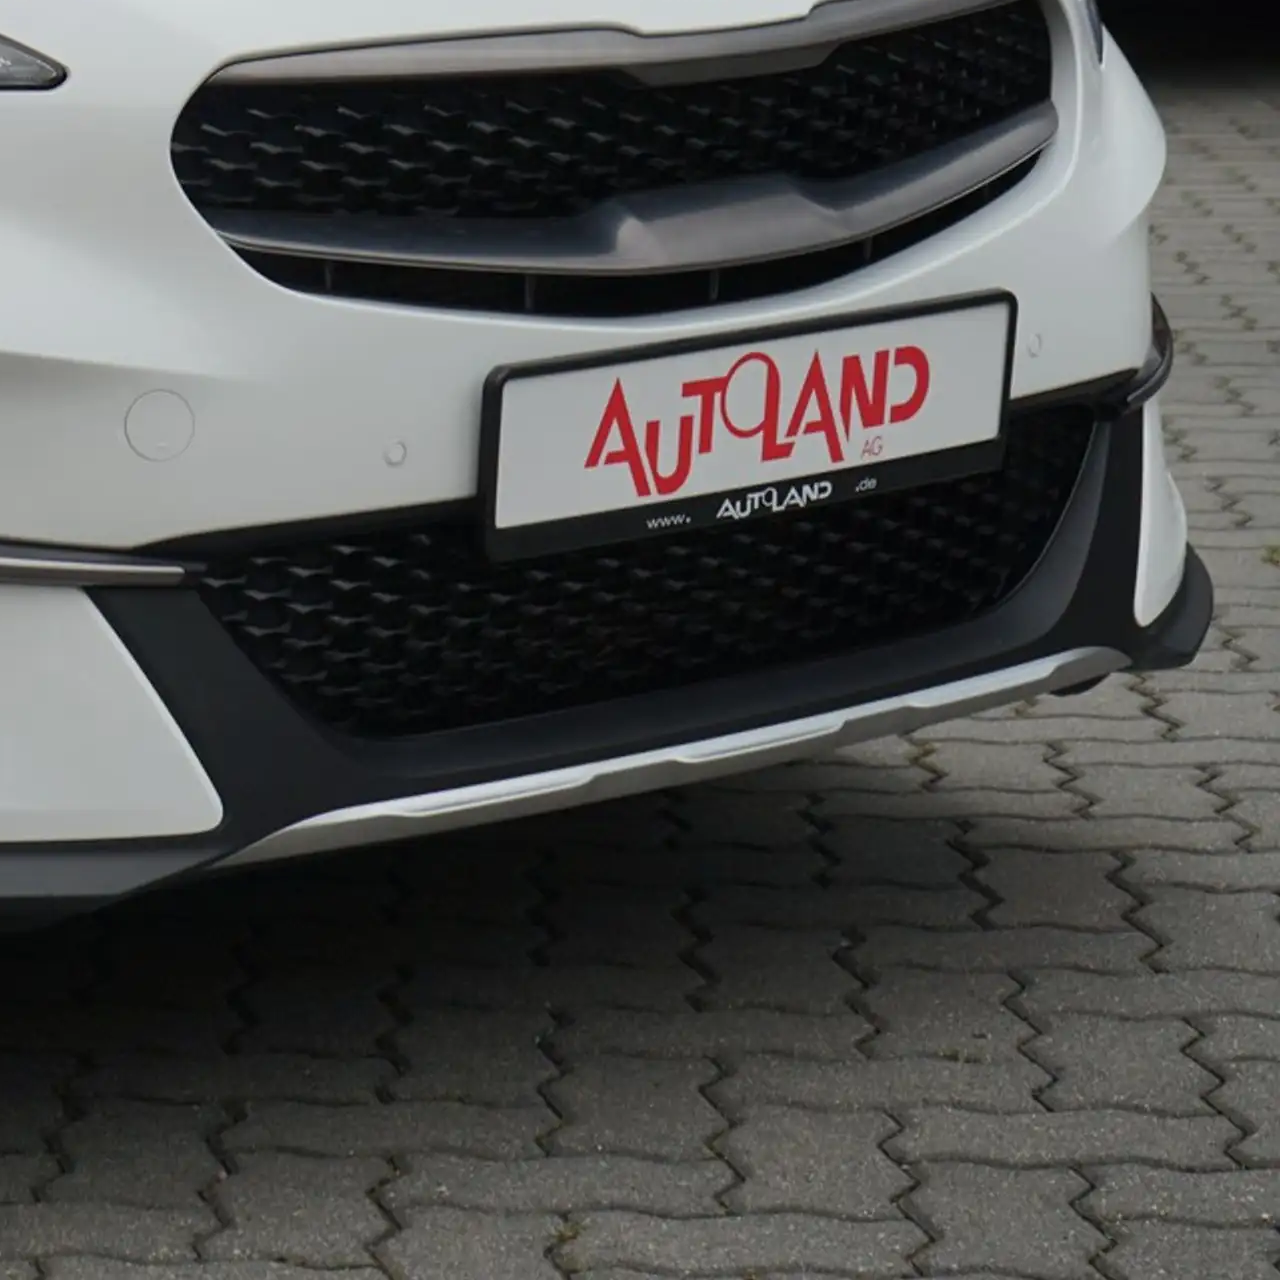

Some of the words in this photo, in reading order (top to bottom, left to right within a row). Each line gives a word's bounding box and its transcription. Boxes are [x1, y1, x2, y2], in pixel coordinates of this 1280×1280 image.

[584, 345, 930, 497] AUTOLAND
[860, 435, 883, 460] AG
[716, 480, 833, 520] AUTOLAND
[855, 475, 877, 493] .de
